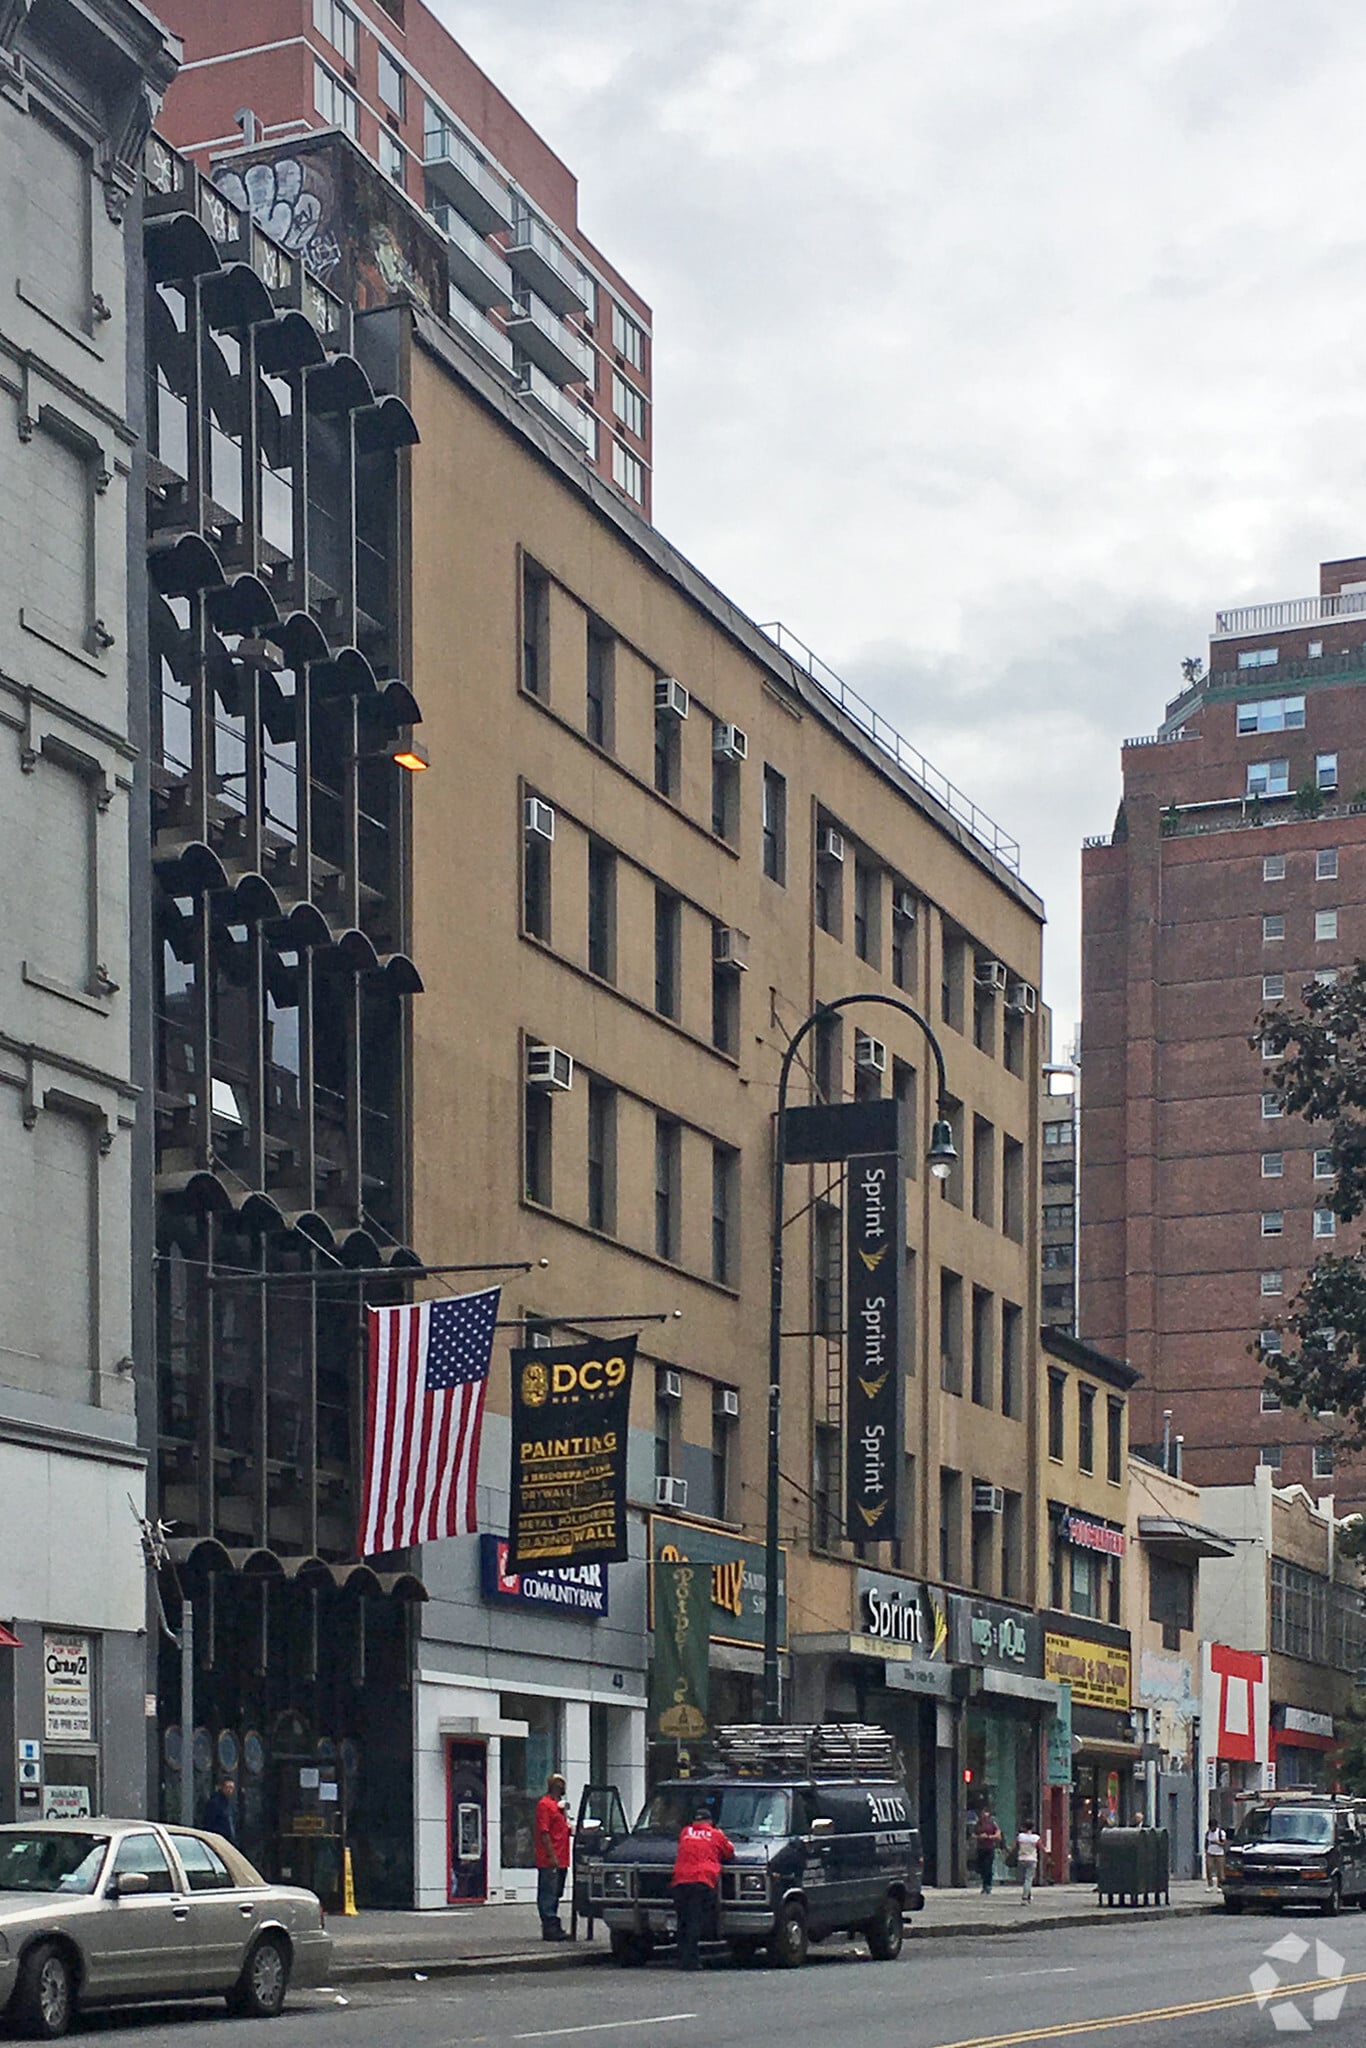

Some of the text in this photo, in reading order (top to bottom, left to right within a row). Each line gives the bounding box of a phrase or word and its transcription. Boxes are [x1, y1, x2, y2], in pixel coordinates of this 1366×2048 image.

[860, 1168, 886, 1238] Sprint
[860, 1296, 886, 1366] Sprint
[552, 1357, 626, 1393] DC9
[520, 1432, 617, 1460] PAINTING
[860, 1425, 886, 1494] Sprint
[574, 1525, 616, 1543] WALL
[579, 1588, 603, 1611] BANK
[868, 1587, 923, 1644] Sprint
[47, 1655, 78, 1676] Century
[867, 1792, 907, 1824] ALTUS
